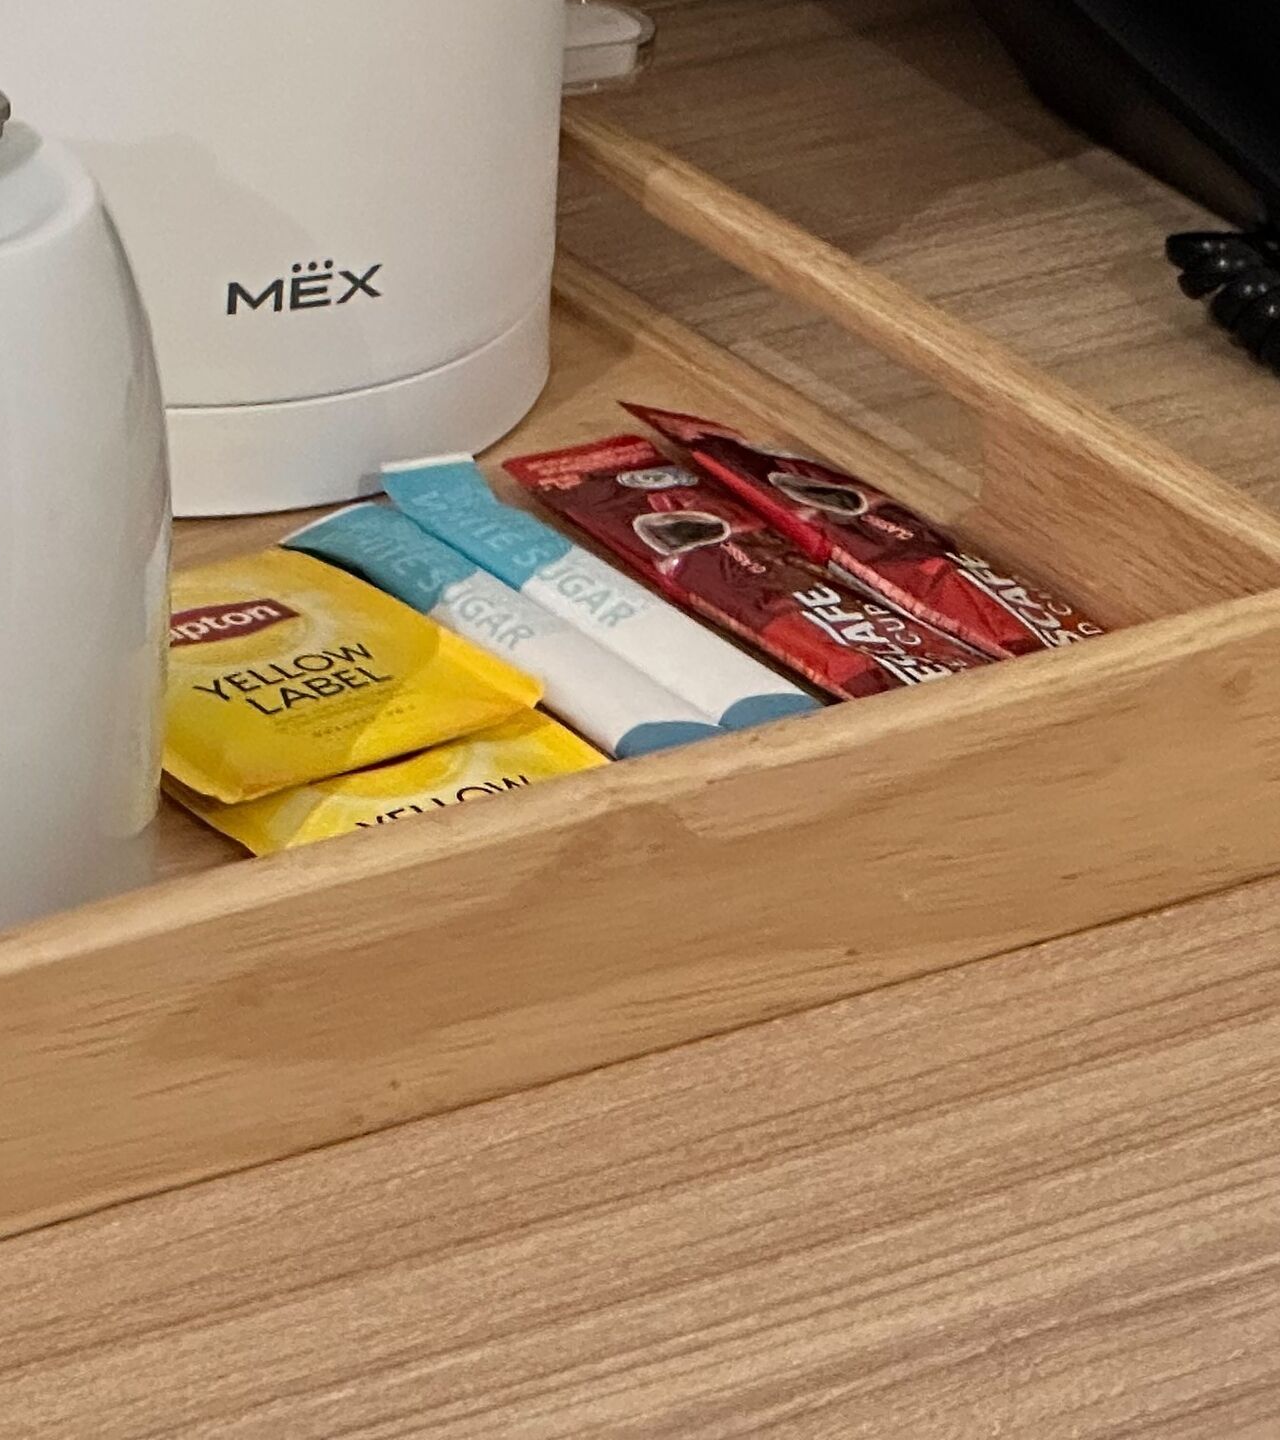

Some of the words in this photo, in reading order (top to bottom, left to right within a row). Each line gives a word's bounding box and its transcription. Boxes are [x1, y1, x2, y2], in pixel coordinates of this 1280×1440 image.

[170, 605, 282, 641] ipton
[862, 603, 923, 646] CUP
[192, 642, 374, 701] YELLOW
[245, 666, 394, 715] LABEL
